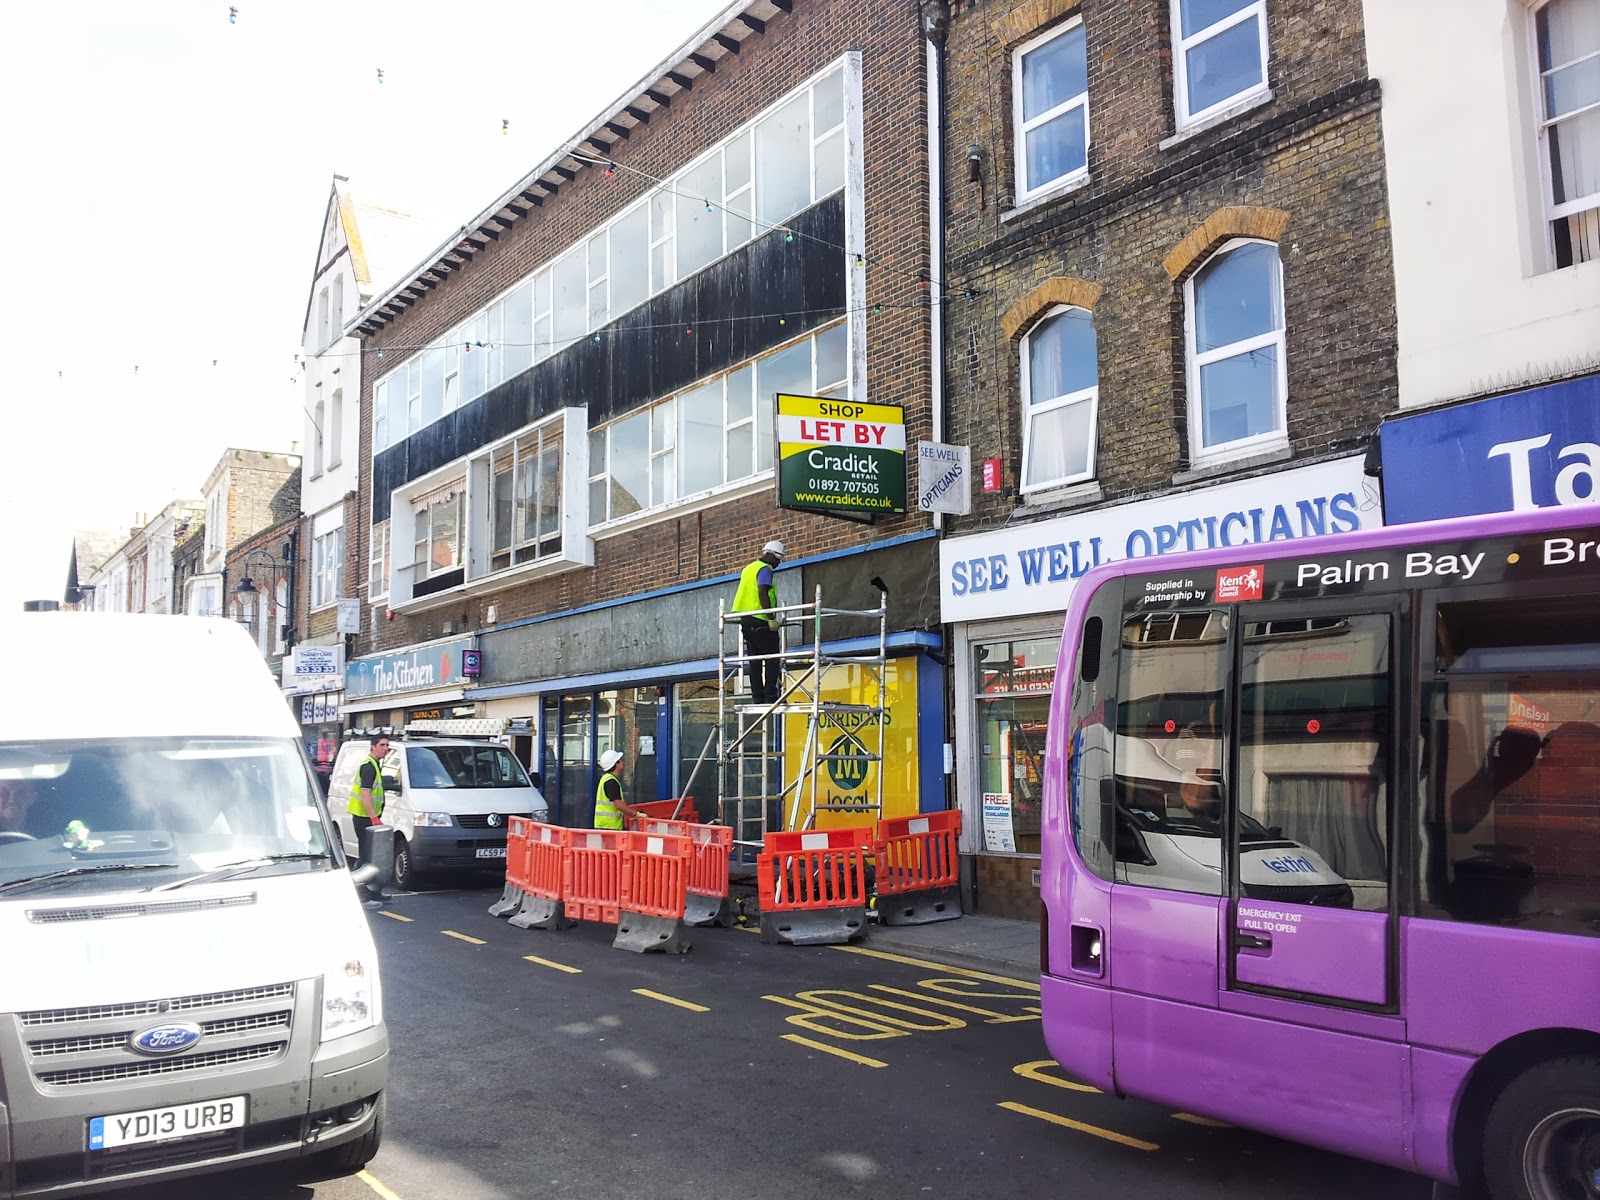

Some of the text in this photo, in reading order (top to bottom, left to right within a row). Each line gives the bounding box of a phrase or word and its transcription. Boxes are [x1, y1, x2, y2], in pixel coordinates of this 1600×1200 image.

[819, 403, 864, 418] SHOP
[800, 419, 887, 445] LET BY
[808, 449, 879, 474] Cradick
[920, 446, 961, 462] SEE WELL
[851, 472, 878, 480] RETAIL
[808, 478, 880, 494] 01892 707505
[921, 463, 963, 509] OPTICIANS
[795, 492, 892, 508] www.cradick.co.uk
[952, 491, 1362, 597] SEE WELL OPTICIANS
[1297, 559, 1389, 587] Palm
[1405, 551, 1486, 579] Bay
[1145, 579, 1193, 592] Supplied in
[1219, 576, 1244, 587] Kent
[1219, 585, 1239, 593] County
[1144, 590, 1206, 604] partnership by
[1219, 590, 1239, 598] Council
[373, 660, 392, 692] The
[393, 653, 434, 689] Kitchen
[827, 789, 870, 814] local
[985, 794, 1009, 805] FREE
[479, 848, 499, 857] LC59
[1239, 907, 1303, 922] EMERGENCY EXIT
[1244, 919, 1297, 933] PULL TO OPEN
[149, 1028, 186, 1048] Ford
[116, 1102, 234, 1140] YD13 URB
